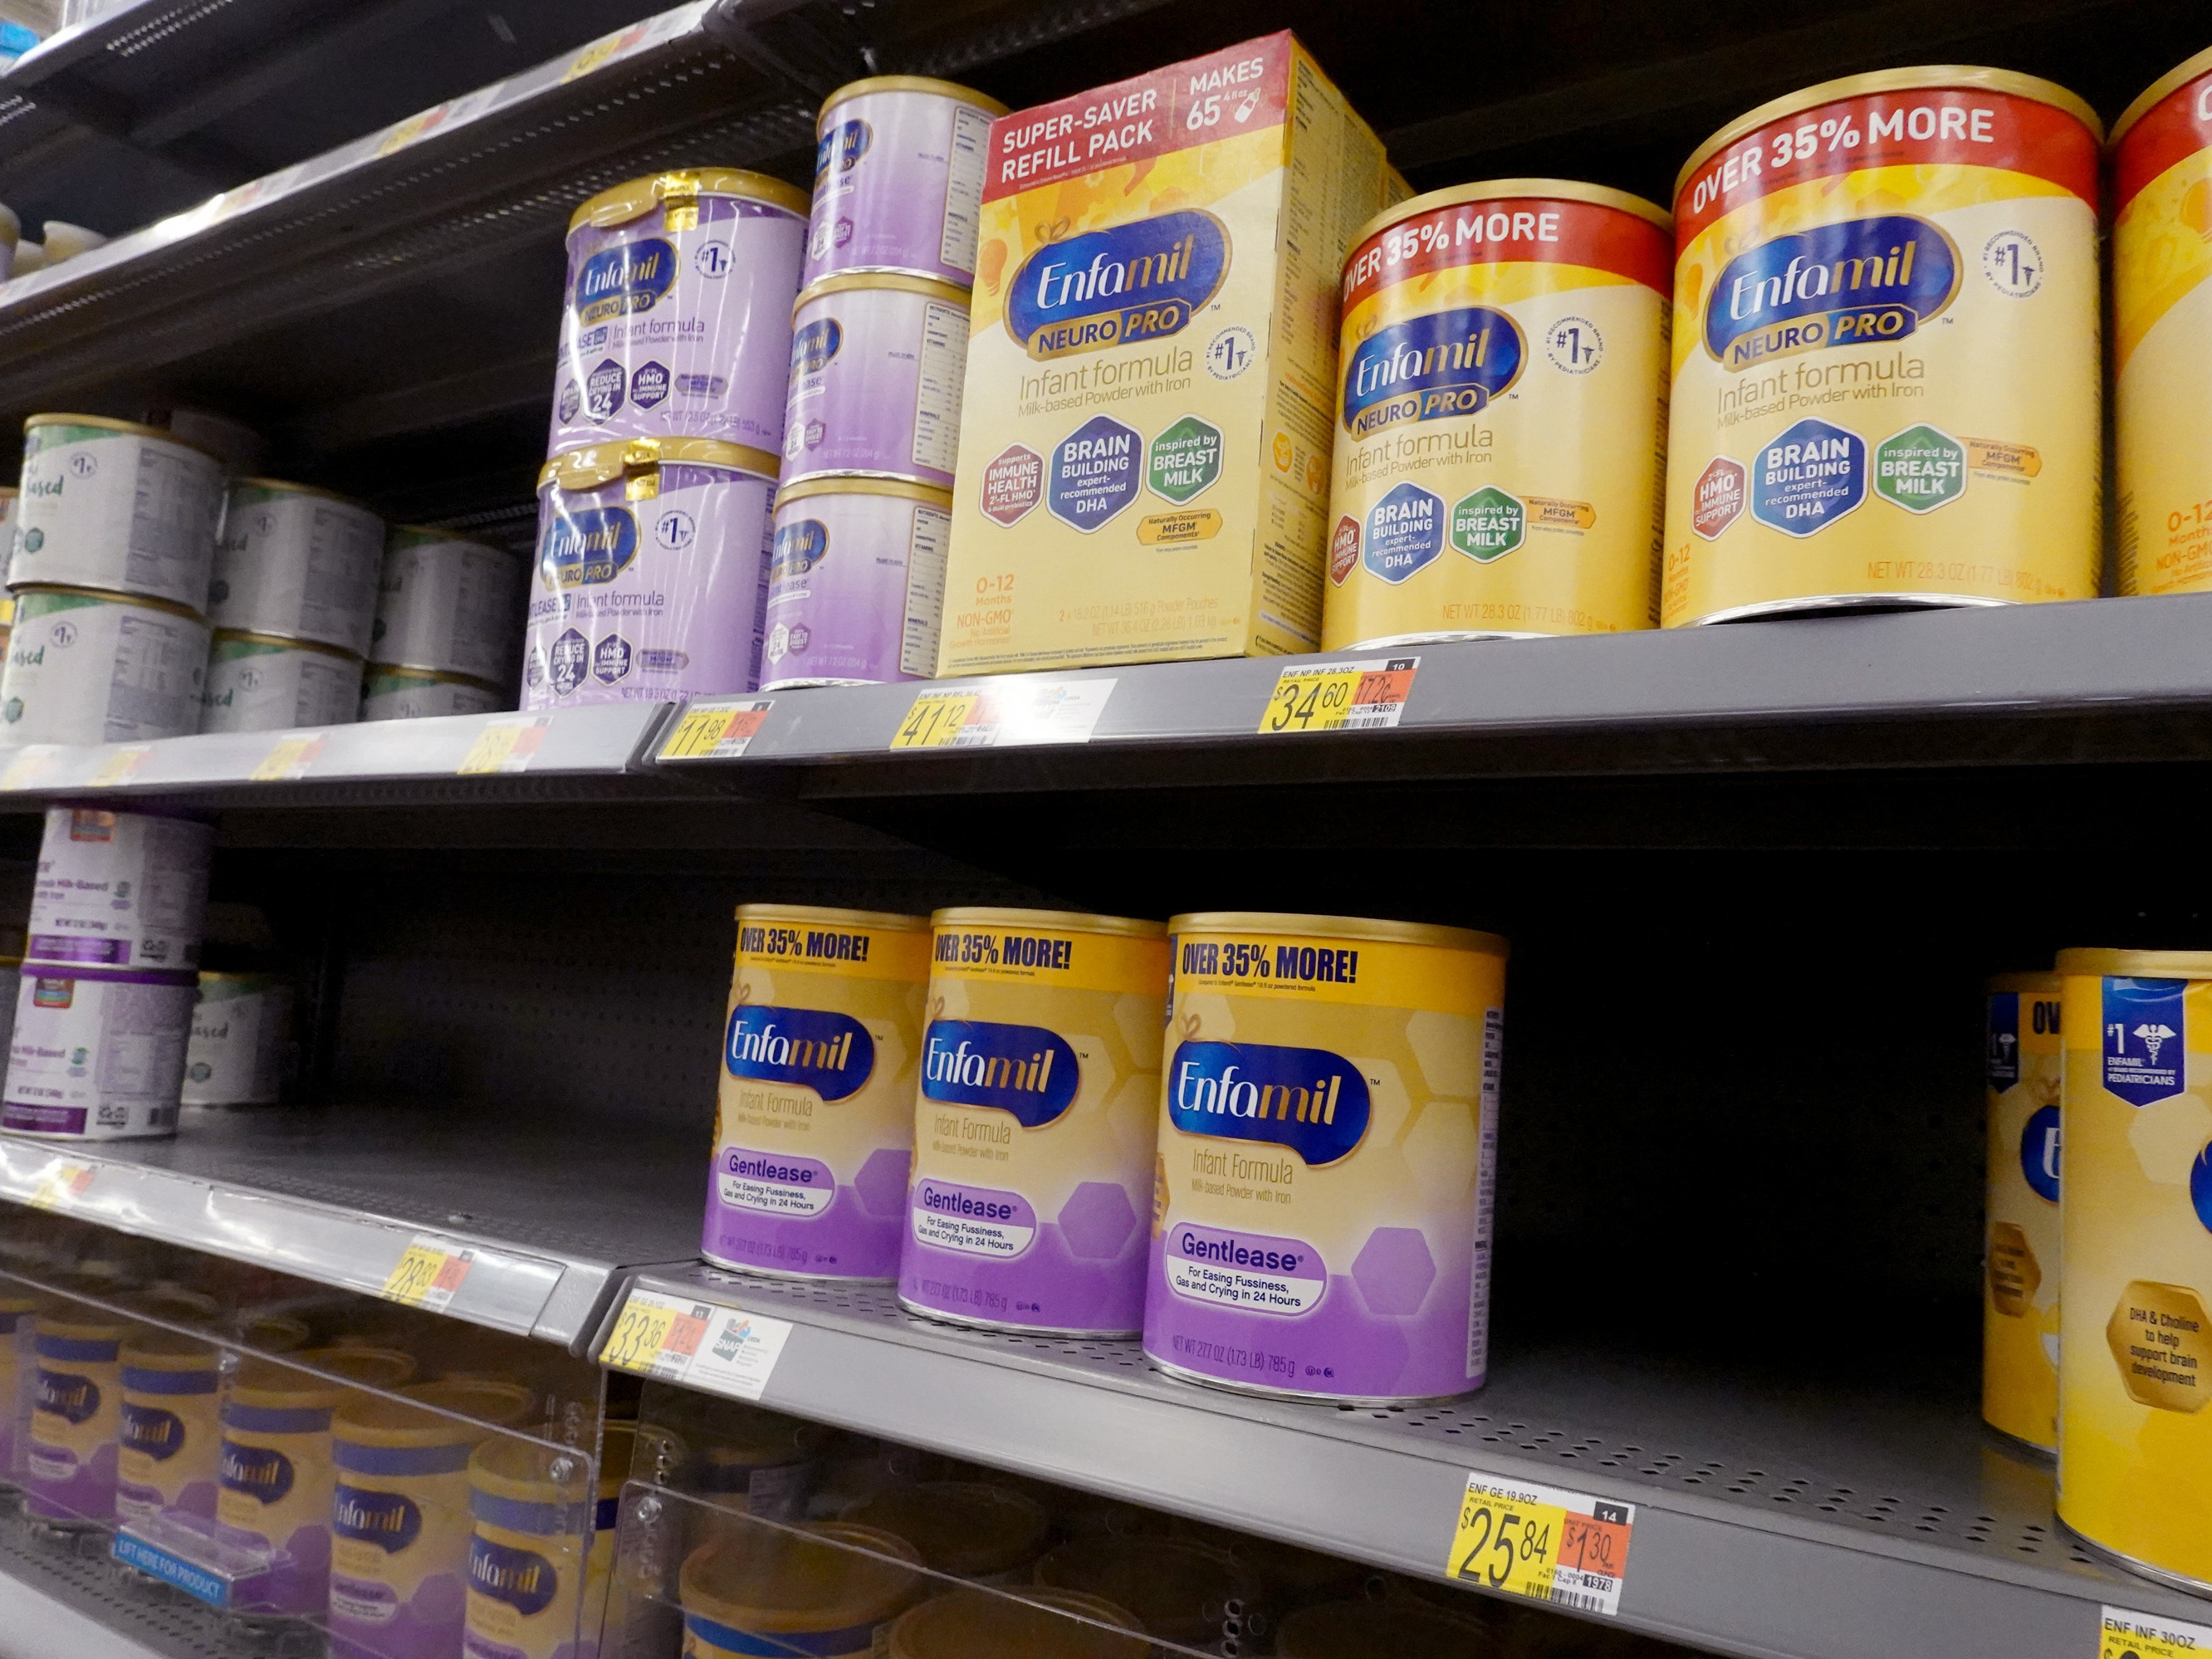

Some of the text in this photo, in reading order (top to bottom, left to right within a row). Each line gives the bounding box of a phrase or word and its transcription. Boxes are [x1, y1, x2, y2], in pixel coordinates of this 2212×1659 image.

[1190, 57, 1264, 95] MAKES
[1002, 88, 1157, 154] SUPER-SAVER
[1186, 95, 1221, 130] 65
[1001, 139, 1081, 184] REFILL
[1088, 120, 1153, 156] PACK
[1692, 146, 1762, 215] OVER
[1770, 115, 1861, 169] 35%
[1867, 106, 1995, 144] MORE
[1342, 247, 1382, 302] OVER
[1387, 220, 1449, 267] 35%
[1455, 213, 1559, 247] MORE
[1994, 243, 2019, 286] #1
[1036, 234, 1194, 310] Enfamil
[1731, 239, 1916, 323] Enfamil
[649, 316, 705, 335] formula
[1038, 305, 1180, 353] NEURO PRO
[1734, 311, 1905, 365] NEURO PRO
[1215, 336, 1234, 370] #1
[1356, 328, 1490, 399] Enfamil
[1019, 345, 1193, 401] Infant formula
[1794, 351, 1926, 393] formula
[592, 392, 612, 413] 24
[1018, 375, 1191, 418] Milk-based Powder with Iron
[1357, 389, 1477, 433] NEURO PRO
[1063, 433, 1131, 464] BRAIN
[1155, 434, 1217, 452] inspired by
[1767, 436, 1850, 468] BRAIN
[1883, 446, 1958, 462] inspired by
[989, 462, 1039, 481] IMMUNE
[998, 453, 1031, 465] supports
[1060, 458, 1129, 479] BUILDING
[1153, 448, 1218, 472] BREAST
[1880, 459, 1960, 479] BREAST
[987, 475, 1037, 495] HEALTH
[1077, 475, 1110, 489] expert-
[1163, 467, 1203, 487] MILK
[1764, 459, 1851, 487] BUILDING
[1060, 482, 1127, 501] recommended
[1895, 478, 1945, 496] MILK
[1075, 497, 1108, 514] DHA
[1148, 511, 1211, 525] Naturally Occurring
[1373, 498, 1434, 526] BRAIN
[1785, 501, 1825, 520] DHA
[661, 517, 678, 543] #1
[1373, 519, 1433, 541] BUILDING
[1456, 516, 1520, 533] BREAST
[1466, 530, 1507, 547] MILK
[1668, 543, 1691, 572] 0-12
[976, 574, 1015, 594] 0-12
[611, 590, 664, 608] formula
[975, 595, 1012, 607] Months
[1442, 604, 1520, 620] NET WT 28.3 OZ
[557, 664, 575, 682] 24
[1283, 670, 1299, 678] ENF
[1313, 668, 1327, 676] INF
[1327, 666, 1355, 675] 28.3OZ
[1375, 704, 1396, 712] 2109
[740, 926, 869, 962] OVER 35% MORE!
[934, 932, 1072, 970] OVER 35% MORE!
[1182, 942, 1358, 985] OVER 35% MORE!
[732, 1020, 854, 1072] Enfamil
[2107, 1023, 2125, 1055] #1
[926, 1036, 1055, 1094] Enfamil
[2107, 1073, 2175, 1086] PEDIATRICIANS
[1177, 1060, 1342, 1126] Enfamil
[1192, 1148, 1294, 1185] Infant Formula
[1192, 1178, 1292, 1204] Milk-based Powder with Iron
[1176, 1275, 1302, 1308] Gas and Crying in 24 Hours
[1188, 1265, 1290, 1294] For Easing Fussiness,
[2130, 1307, 2200, 1333] DHA & Choline
[715, 1338, 740, 1352] SNAP
[1172, 1334, 1184, 1349] NET
[1184, 1337, 1196, 1354] WT
[2145, 1329, 2180, 1350] to help
[2130, 1344, 2198, 1369] support brain
[2131, 1361, 2196, 1387] development
[1468, 1482, 1538, 1506] ENF GE 19.9OZ
[1469, 1496, 1514, 1512] RETAIL PRICE
[1602, 1510, 1617, 1523] 14
[1587, 1576, 1612, 1592] 1978
[2105, 1617, 2196, 1651] ENF INF 30OZ
[2108, 1636, 2175, 1657] RETAIL PRICE
